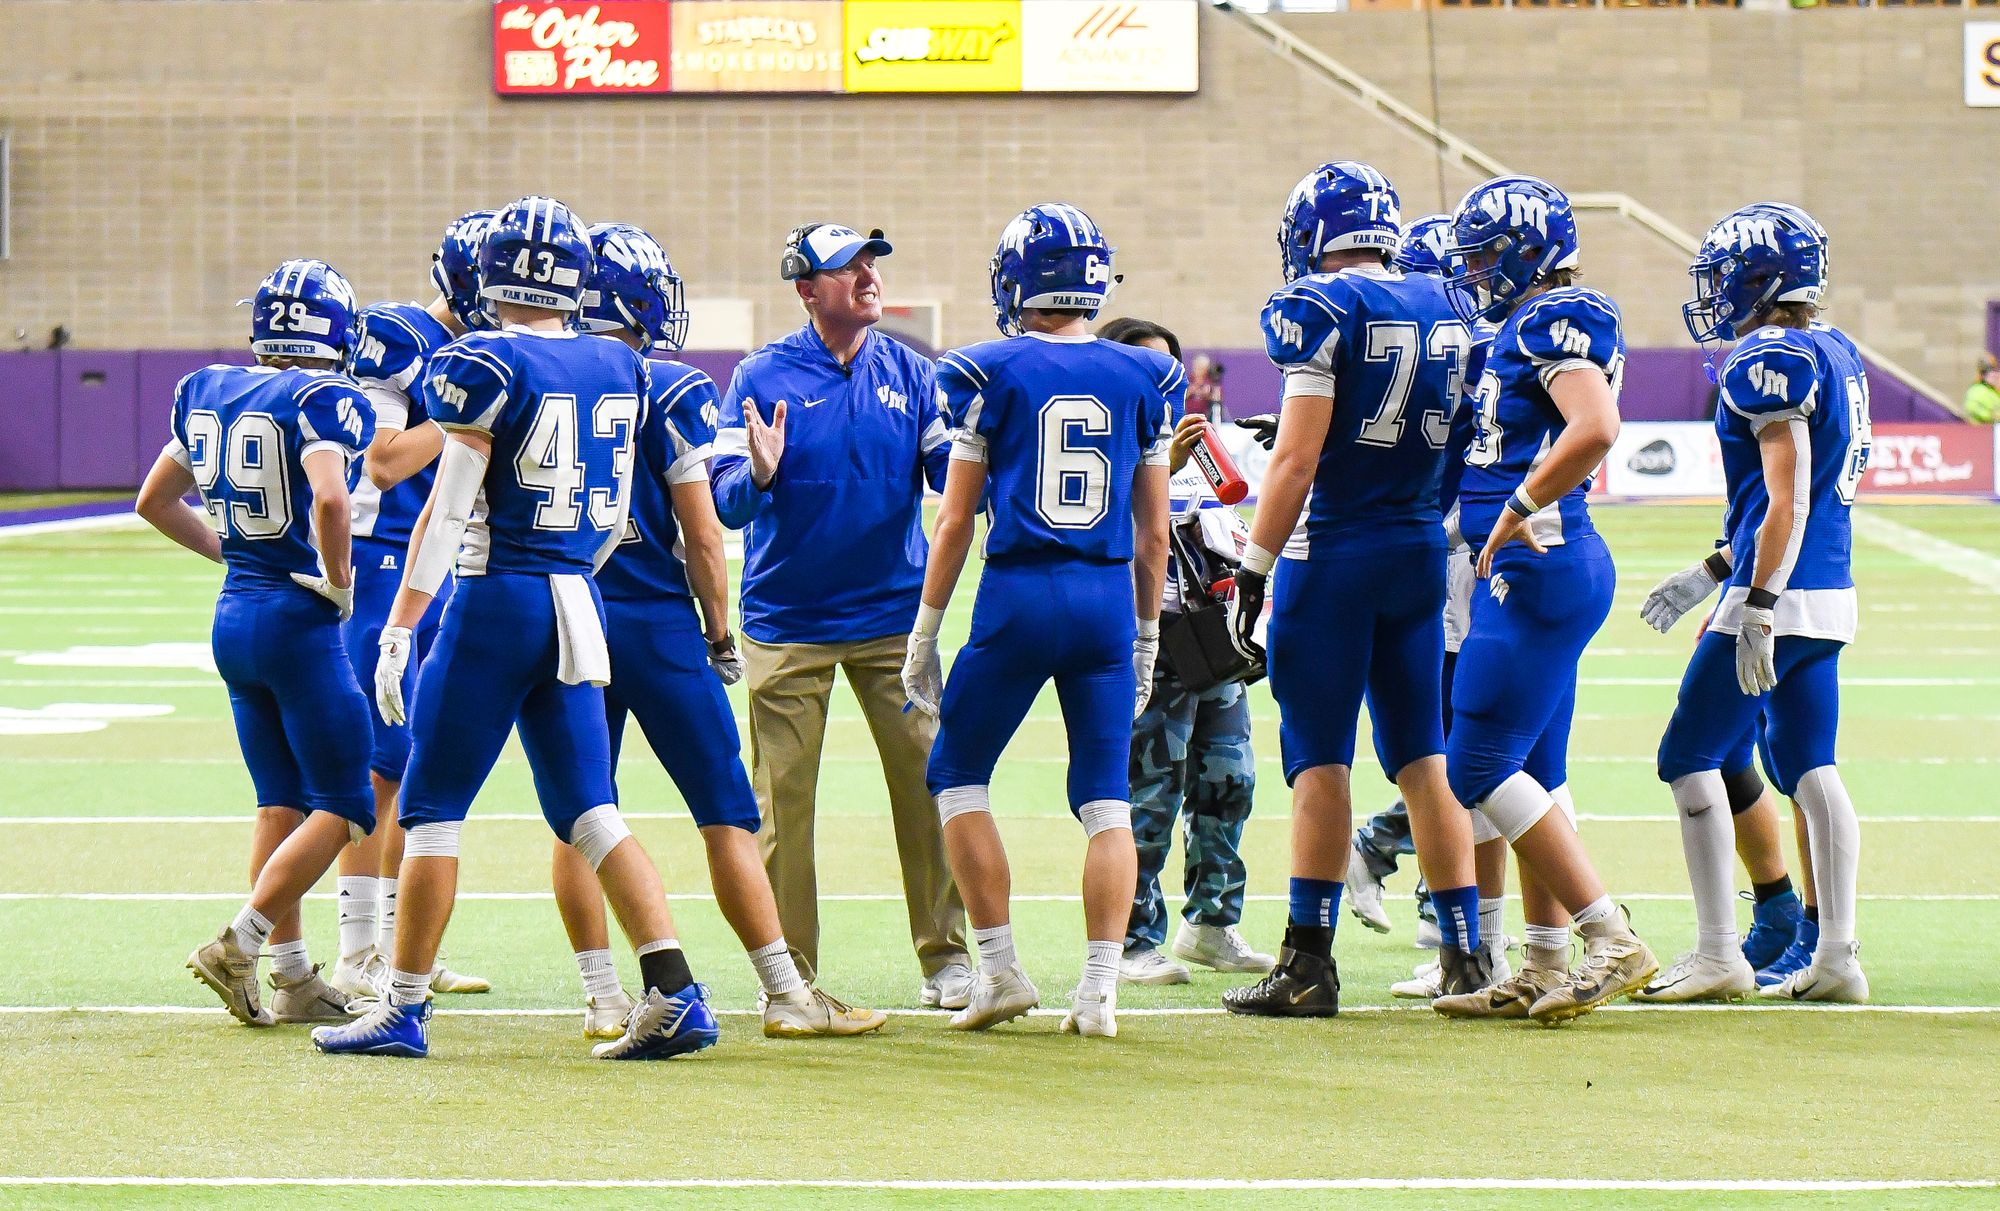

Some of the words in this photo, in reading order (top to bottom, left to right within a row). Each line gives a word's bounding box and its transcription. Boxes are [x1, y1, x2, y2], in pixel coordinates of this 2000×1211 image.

[532, 6, 640, 49] Other
[855, 22, 1014, 64] SUBWAY
[564, 47, 660, 90] Place
[671, 52, 844, 72] SMOKEHOUSE
[1361, 192, 1400, 226] 73
[1480, 188, 1548, 241] VM
[1353, 234, 1371, 244] VAN
[1704, 219, 1780, 254] VM
[513, 248, 555, 283] 43
[269, 301, 307, 332] 29
[502, 289, 520, 301] VAN
[524, 292, 558, 306] METER
[1053, 296, 1072, 305] VAN
[263, 344, 280, 353] VAN
[282, 344, 316, 354] METER
[1270, 309, 1303, 351] VM
[1550, 318, 1591, 358] VM
[433, 374, 468, 413] VM
[876, 385, 908, 415] VM
[1355, 320, 1472, 450] 73
[1748, 361, 1788, 402] VM
[336, 397, 363, 446] VM
[1464, 368, 1504, 468] 3
[514, 393, 639, 532] 43
[1036, 395, 1111, 529] 6
[1865, 435, 1941, 469] EY'S
[186, 409, 293, 541] 29
